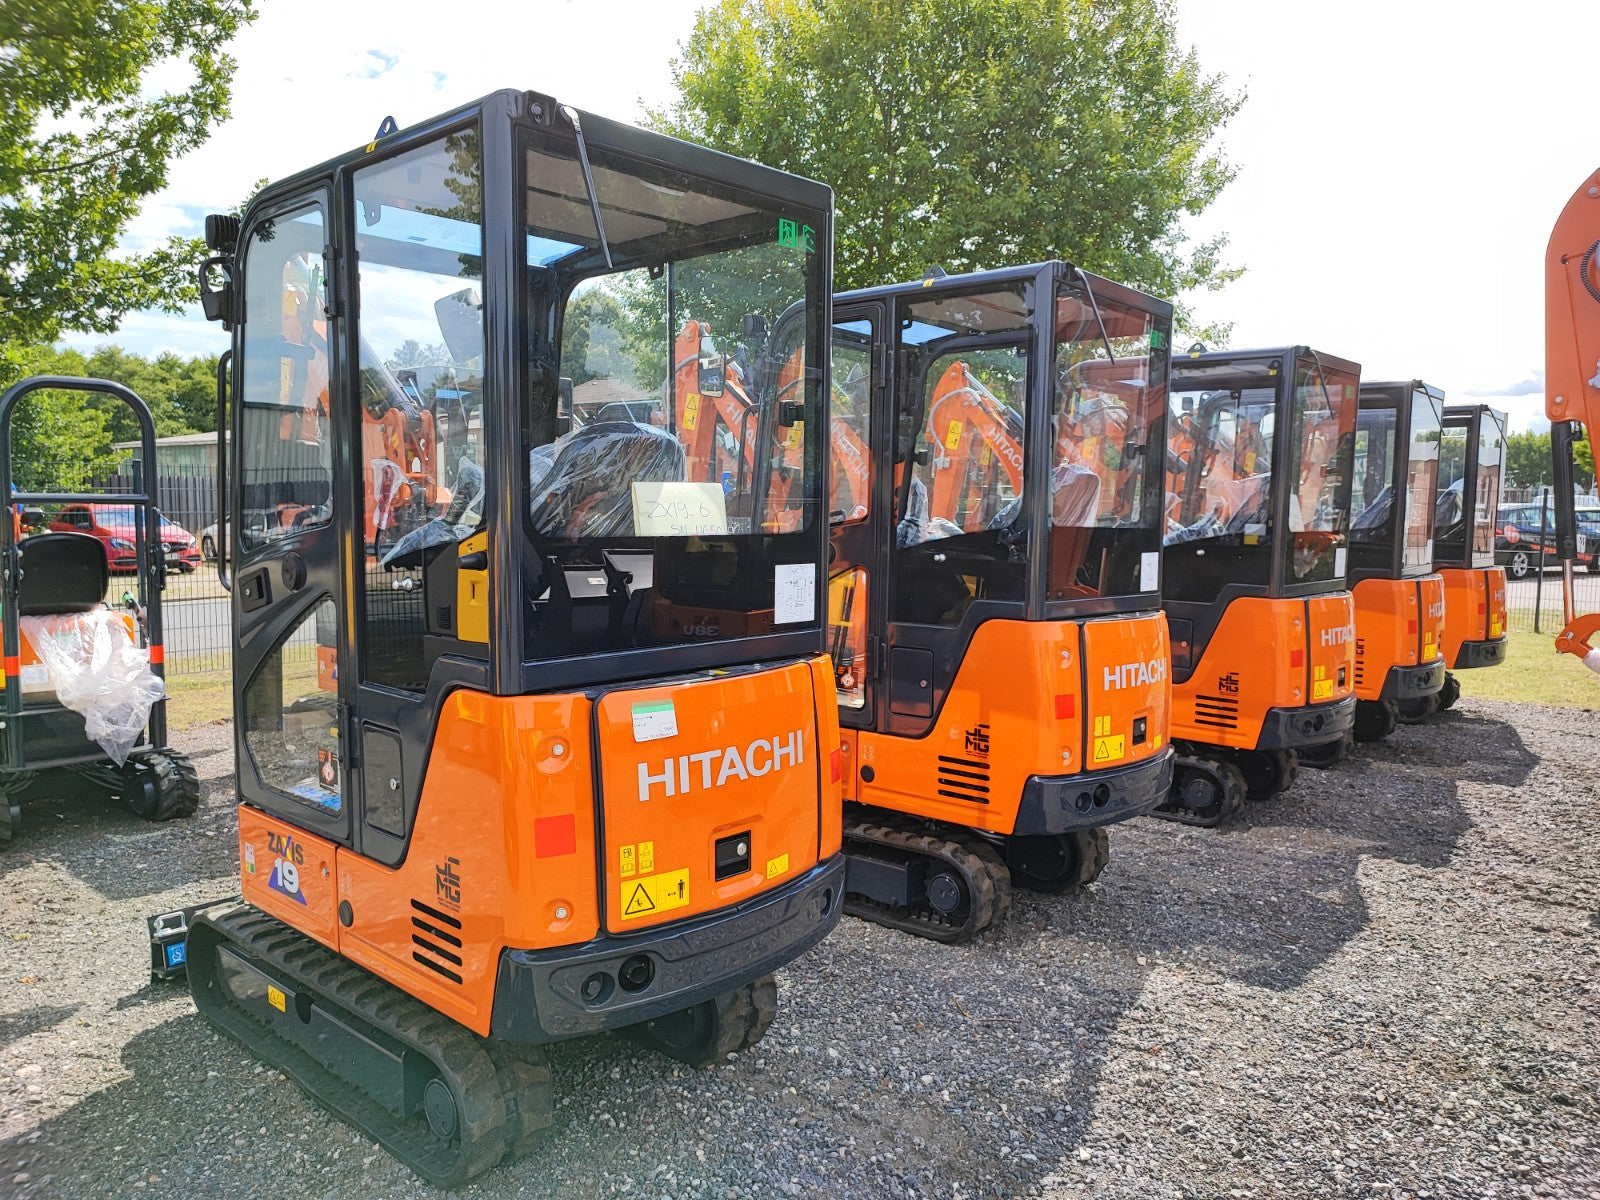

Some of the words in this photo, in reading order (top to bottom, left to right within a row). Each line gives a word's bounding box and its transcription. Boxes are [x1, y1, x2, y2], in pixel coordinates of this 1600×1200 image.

[1104, 657, 1167, 691] HITACHI
[637, 729, 804, 802] HITACHI
[267, 831, 304, 866] ZAXIS
[274, 857, 300, 894] 19
